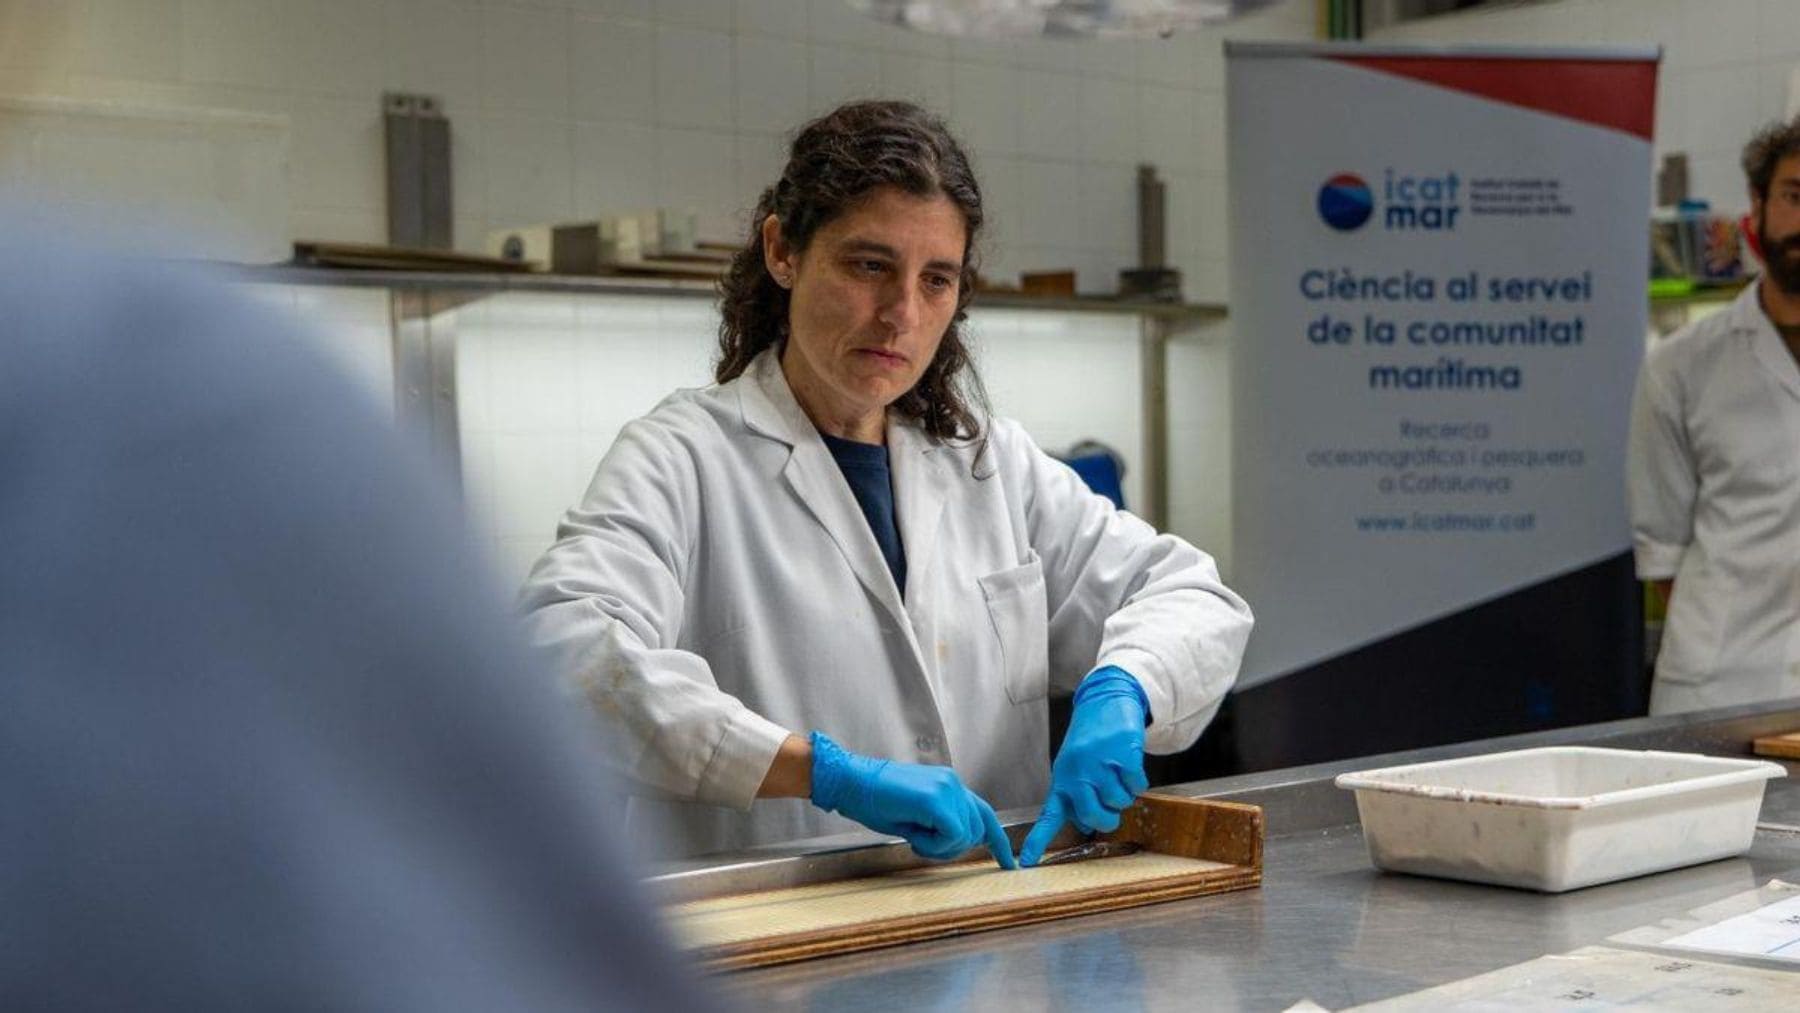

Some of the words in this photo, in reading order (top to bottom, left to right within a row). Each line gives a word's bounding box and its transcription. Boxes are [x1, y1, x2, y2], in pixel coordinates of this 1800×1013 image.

[1385, 169, 1461, 200] icat
[1385, 204, 1461, 230] mar
[1300, 267, 1434, 300] Ciència
[1447, 271, 1477, 300] al
[1489, 271, 1592, 300] servei
[1308, 316, 1352, 344] de
[1365, 316, 1396, 344] la
[1407, 316, 1584, 344] comunitat
[1370, 357, 1522, 390] marítima
[1400, 421, 1490, 440] Recerca
[1482, 450, 1584, 470] pesquera
[1379, 477, 1394, 493] a
[1401, 474, 1512, 496] Catalunya
[1356, 512, 1536, 531] www.icatmar.cat
